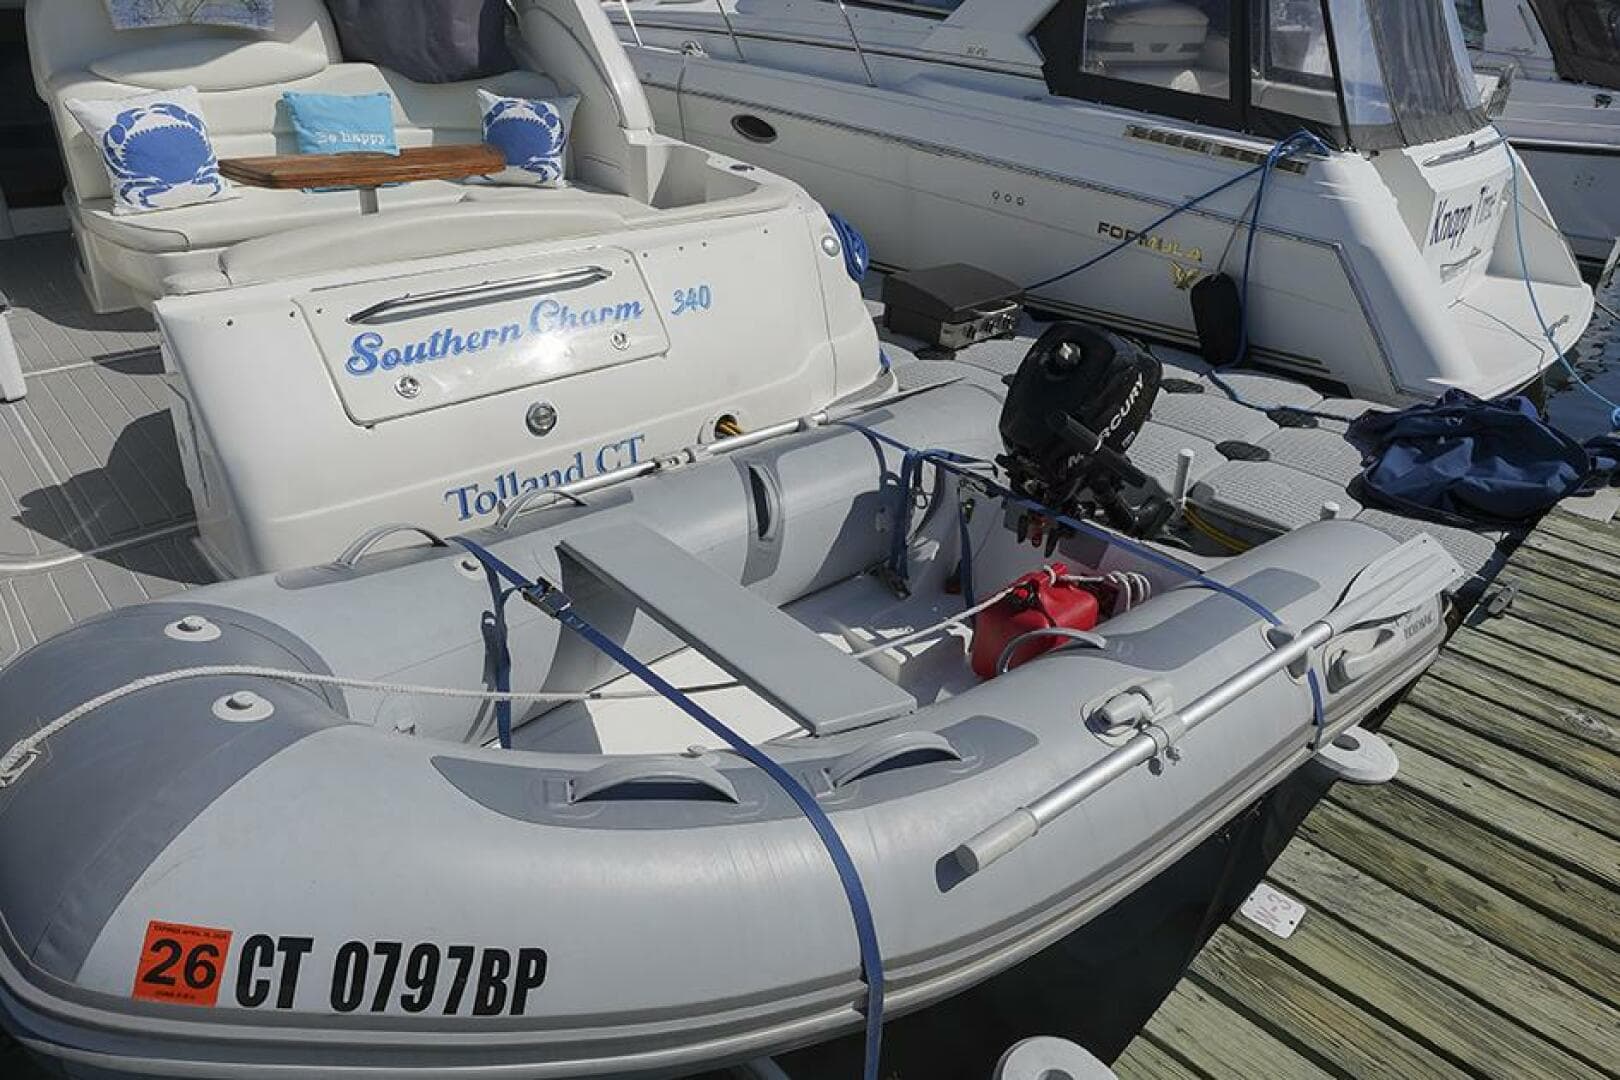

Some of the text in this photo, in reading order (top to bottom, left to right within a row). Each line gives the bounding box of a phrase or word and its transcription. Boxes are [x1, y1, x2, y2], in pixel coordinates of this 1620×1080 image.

[339, 129, 385, 146] happy
[1097, 221, 1203, 262] FORMULA
[671, 284, 713, 315] 340
[346, 299, 643, 376] Southern Charm
[444, 434, 645, 521] Tolland CT
[142, 938, 219, 989] 26
[235, 933, 548, 1015] CT 0797BP
